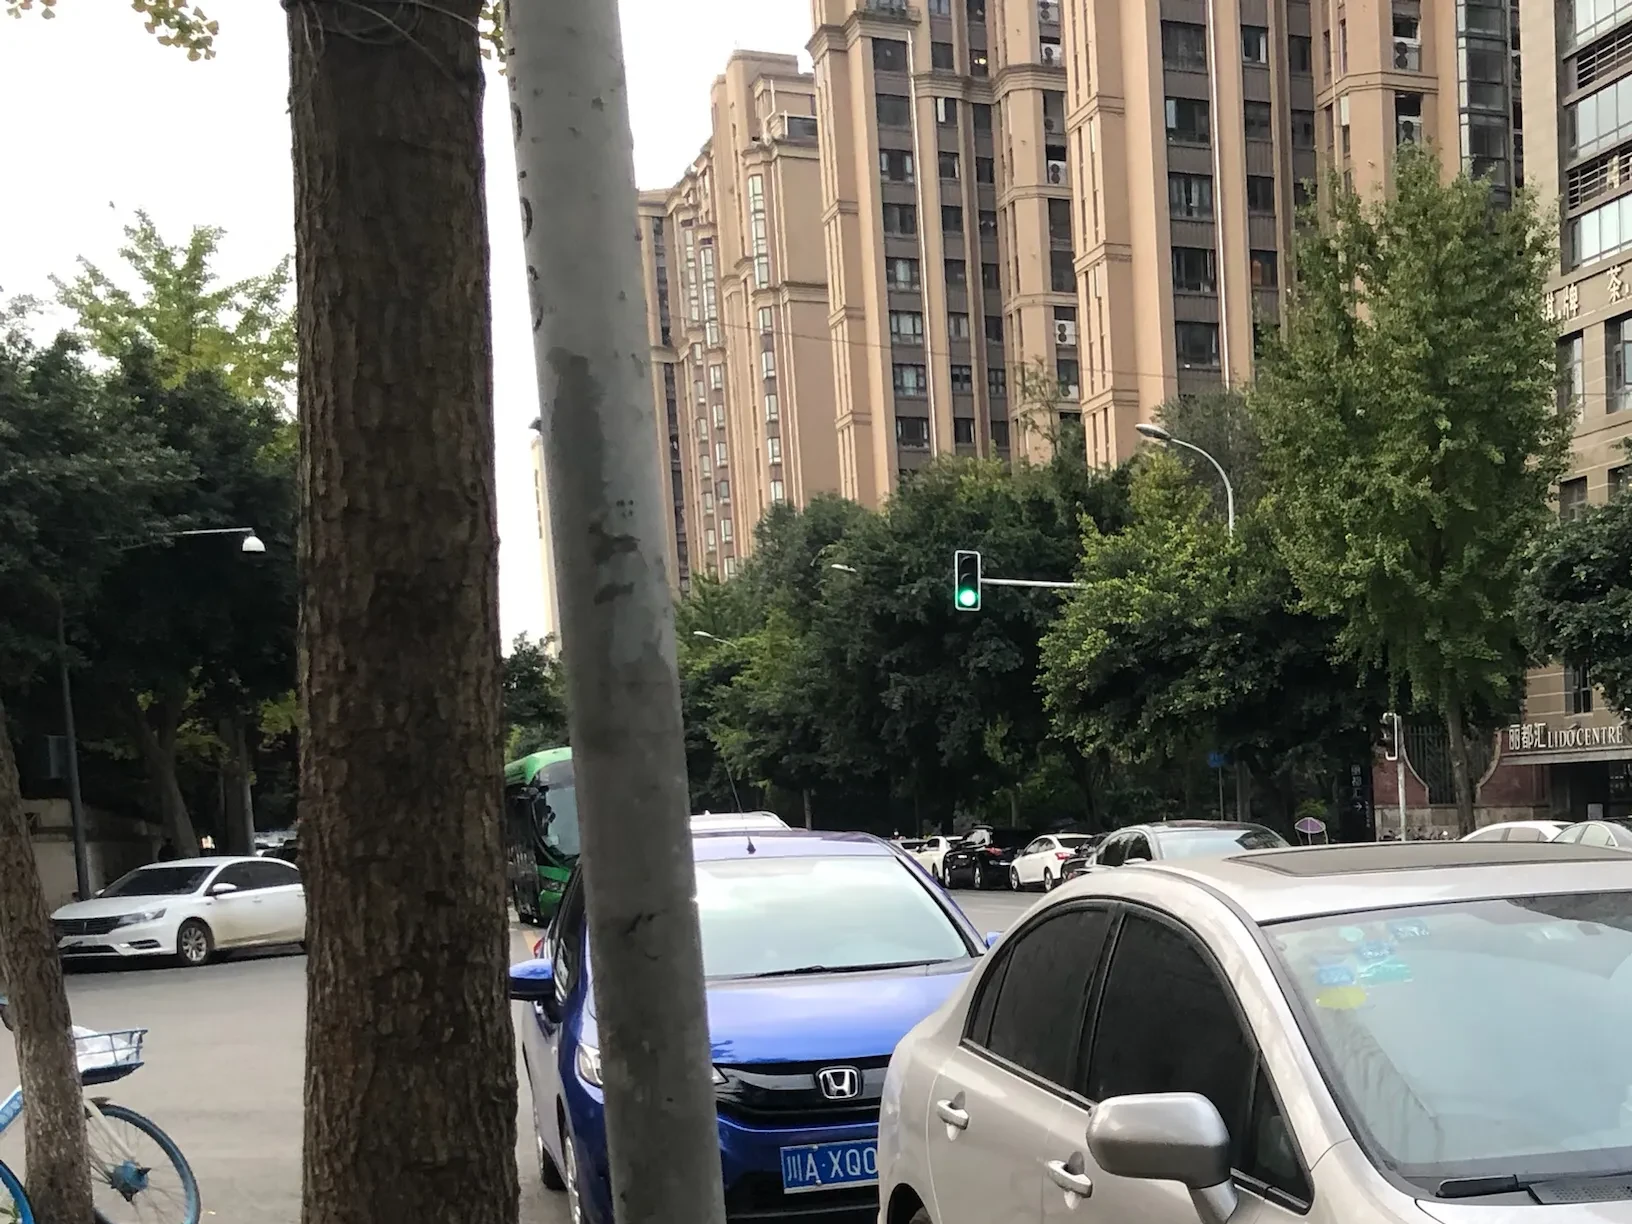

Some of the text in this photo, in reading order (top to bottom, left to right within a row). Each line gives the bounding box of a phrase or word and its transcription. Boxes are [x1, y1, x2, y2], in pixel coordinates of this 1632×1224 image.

[1508, 722, 1624, 751] 丽都汇 LIDO CENTRE
